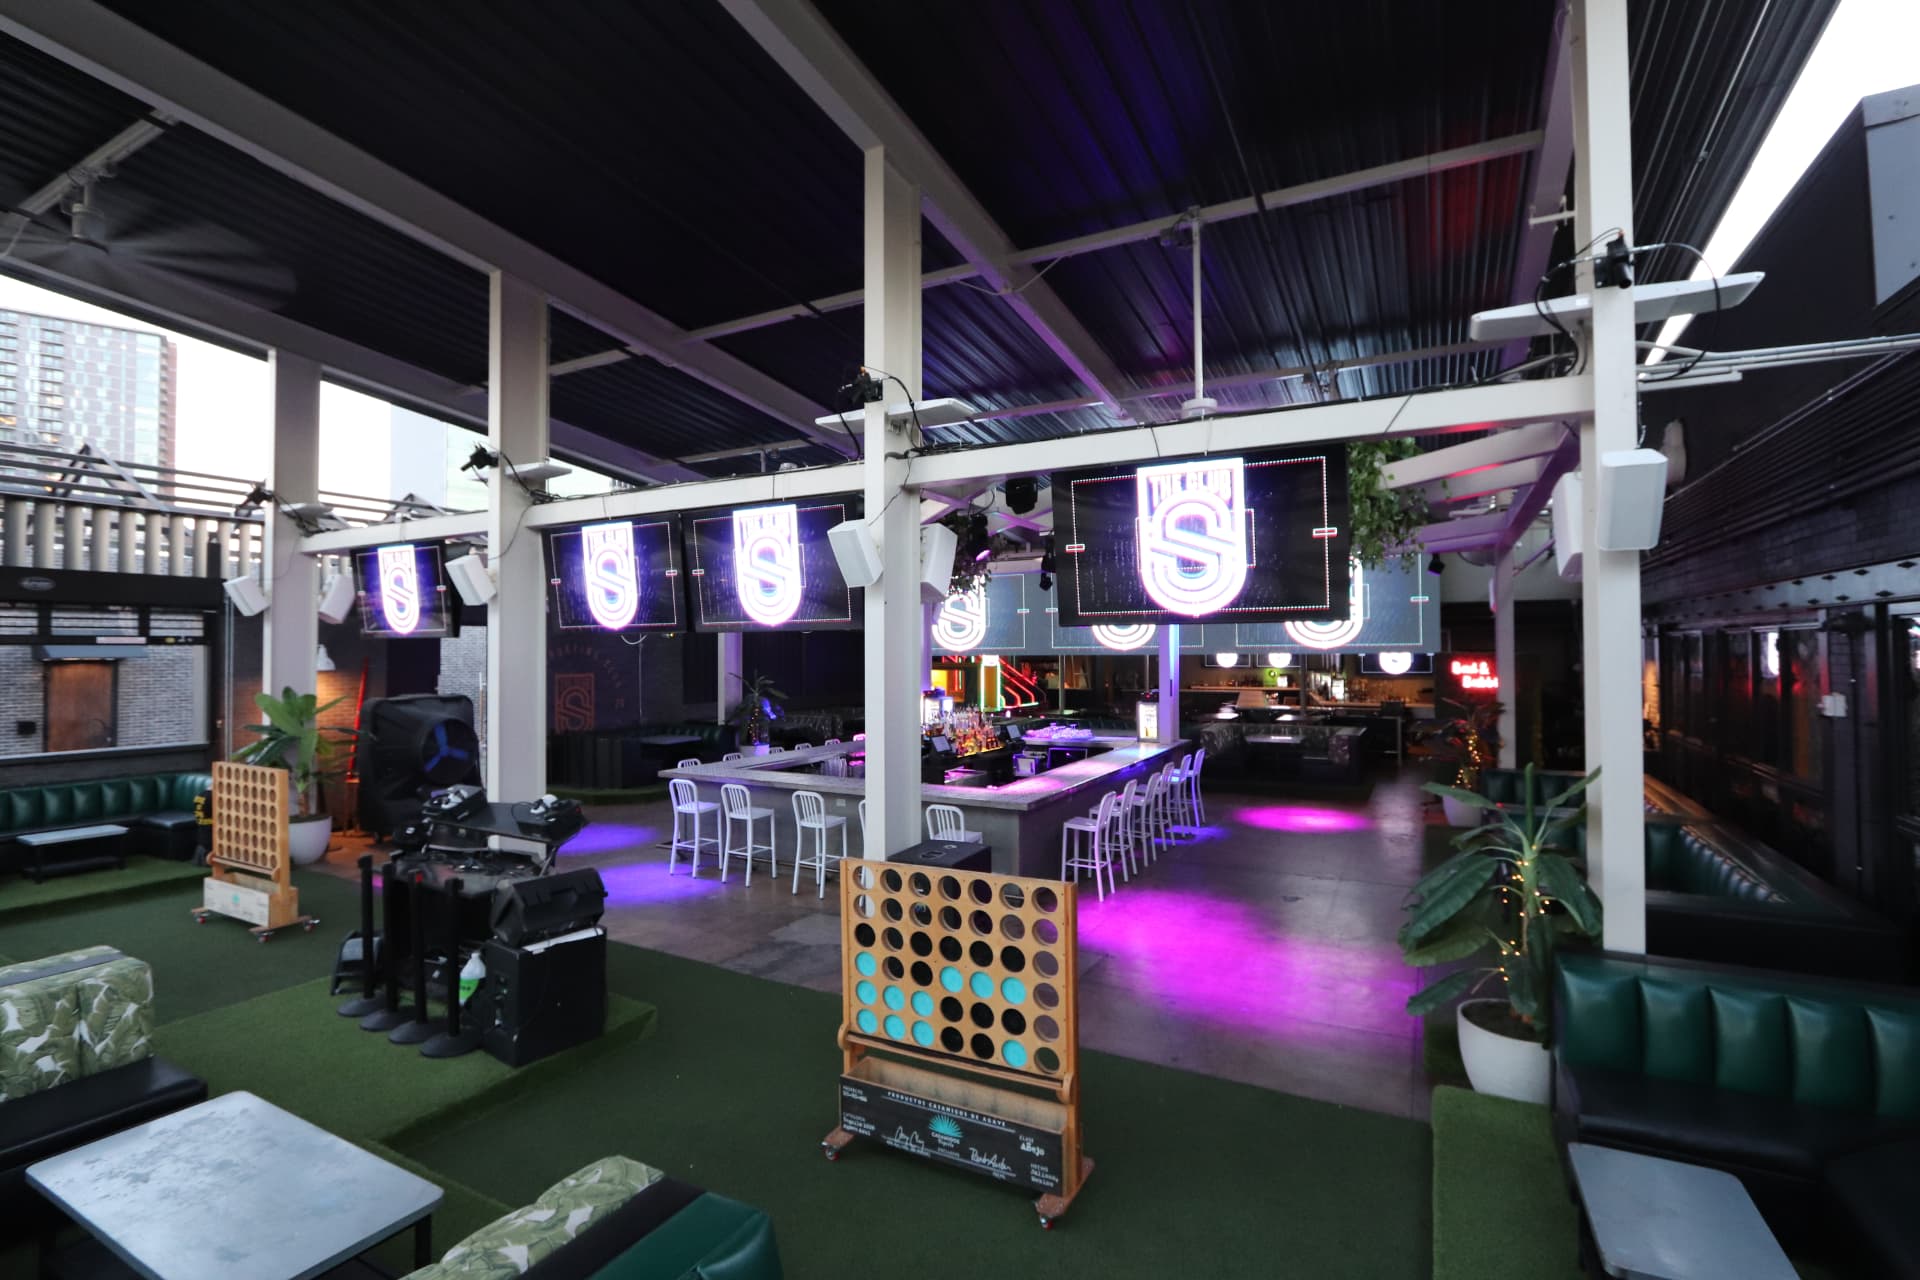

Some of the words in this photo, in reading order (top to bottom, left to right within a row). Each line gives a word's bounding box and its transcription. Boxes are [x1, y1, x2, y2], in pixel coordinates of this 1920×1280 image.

[1149, 473, 1183, 507] THE
[1186, 469, 1232, 502] CLUB
[887, 1091, 926, 1107] PRODUCTOS
[970, 1112, 979, 1120] DE
[982, 1115, 1007, 1127] AGAVE
